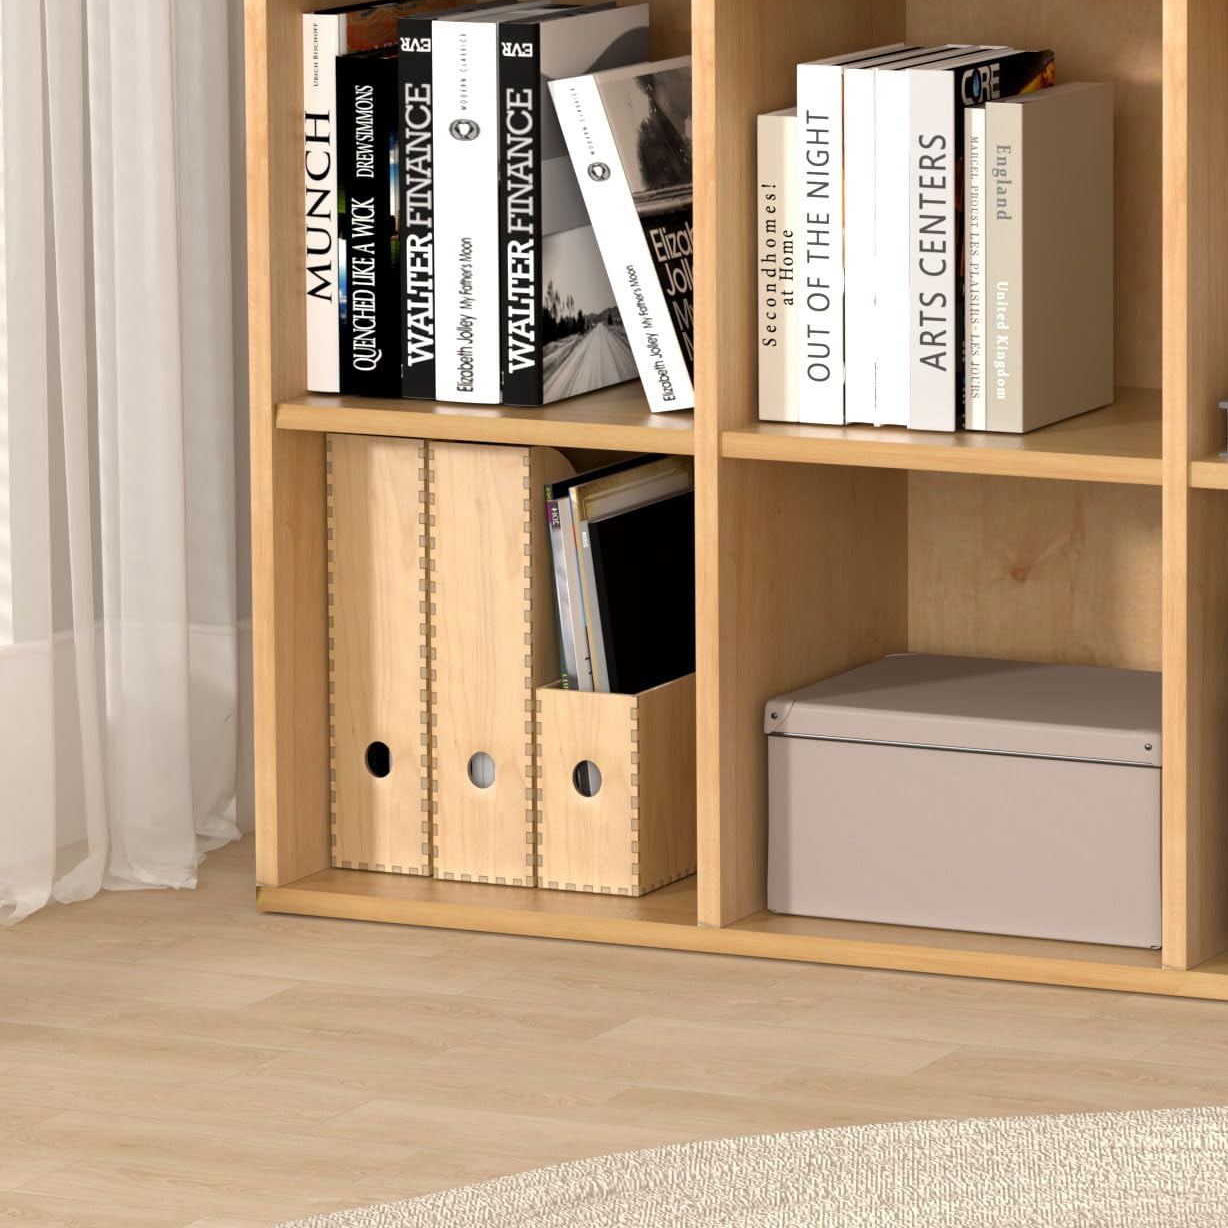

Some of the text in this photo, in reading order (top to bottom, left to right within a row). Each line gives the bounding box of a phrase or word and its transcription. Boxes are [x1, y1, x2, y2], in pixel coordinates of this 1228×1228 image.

[400, 37, 432, 53] EVR
[501, 42, 533, 58] EVR
[306, 110, 333, 303] MUNCH
[970, 136, 980, 180] MARCEL
[970, 185, 980, 228] PROUST
[991, 144, 1013, 221] England
[351, 84, 383, 371] QUENCHED LIKE A WICK DREW SIMMONS
[405, 83, 434, 367] WALTER FINANCE
[506, 88, 536, 374] WALTER FINANCE
[761, 184, 777, 347] Secondhomes!
[778, 230, 794, 306] at Home
[807, 110, 831, 382] OUT OF THE NIGHT
[919, 134, 947, 372] ARTS CENTERS
[970, 233, 980, 256] LES
[456, 237, 477, 393] Elizabeth Jolley My Father's Moon
[626, 264, 676, 402] Elizabeth Jolley My Father's Moon
[970, 334, 980, 357] LES
[993, 281, 1010, 399] United Kingdom
[970, 362, 980, 399] JOURS
